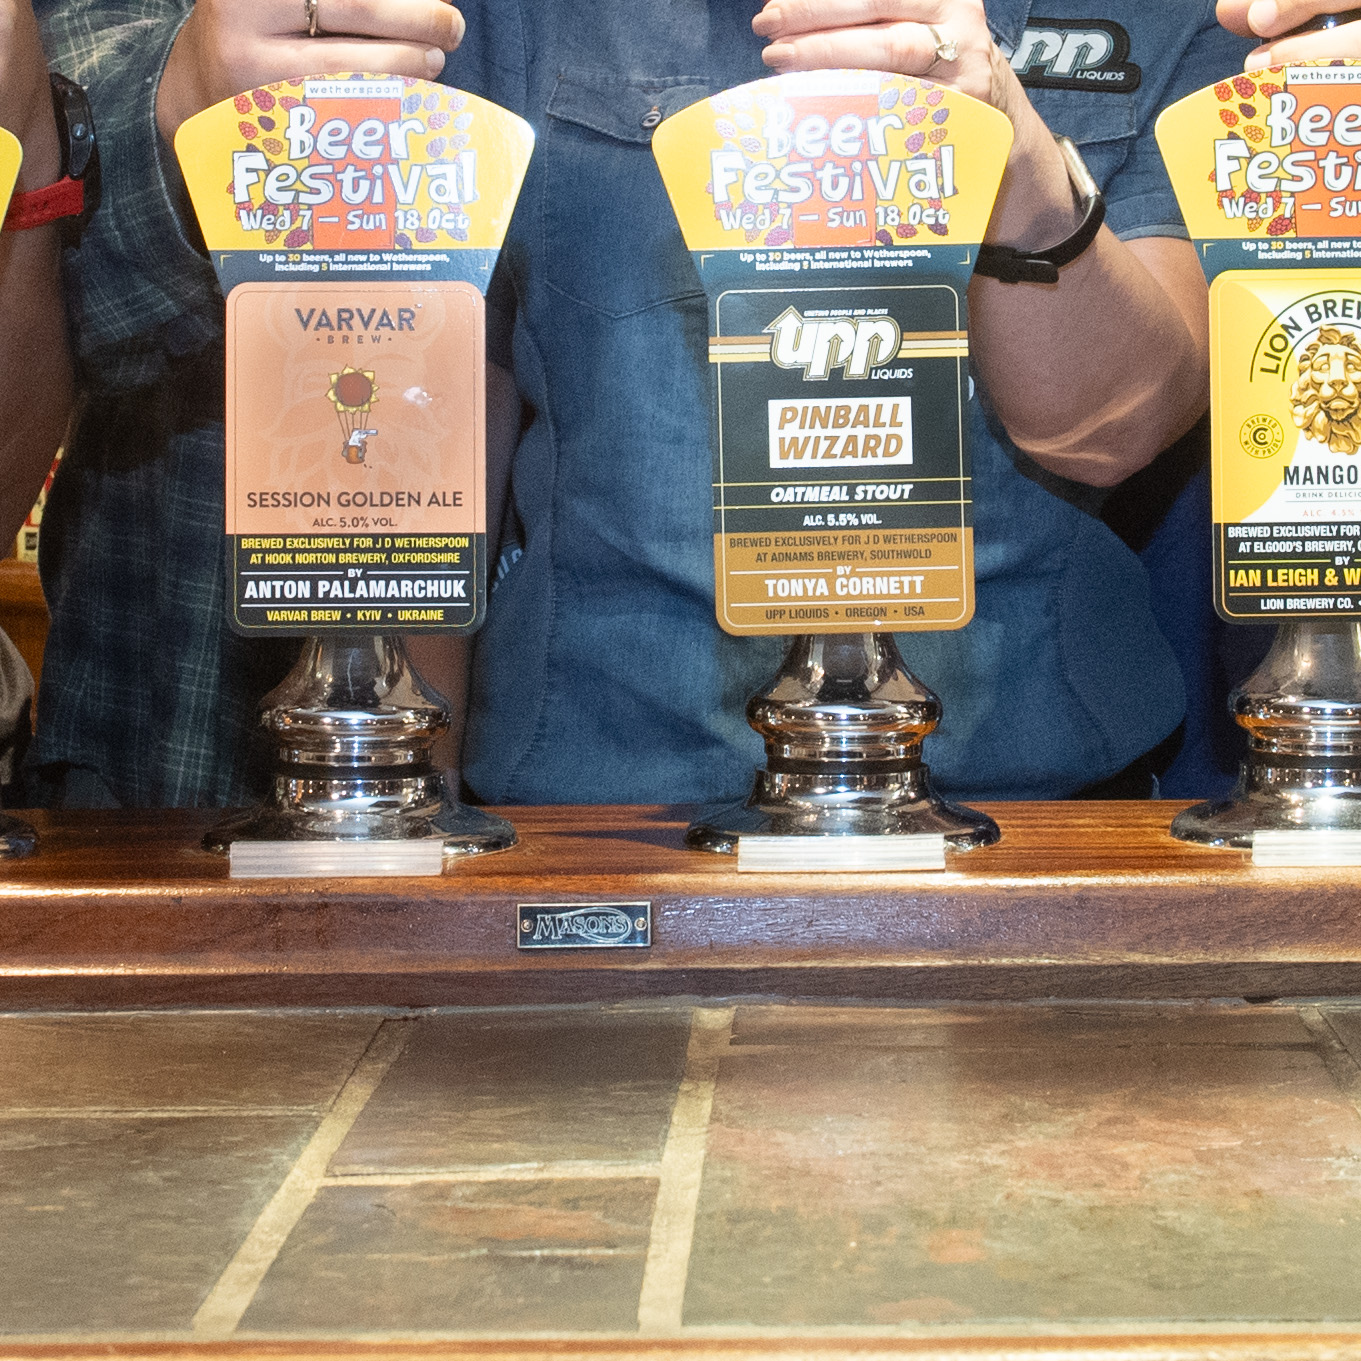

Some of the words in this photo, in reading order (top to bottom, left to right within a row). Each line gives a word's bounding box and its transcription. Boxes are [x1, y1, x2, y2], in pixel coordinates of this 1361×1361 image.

[1076, 71, 1125, 81] LIQUIDS
[309, 85, 400, 96] wetherspoon
[285, 104, 426, 161] Beer
[761, 103, 905, 159] Beer
[231, 150, 480, 205] Festival
[709, 144, 956, 204] Festival
[294, 308, 415, 331] VARVAR
[327, 334, 381, 343] BREW
[1260, 319, 1302, 375] LION
[871, 368, 913, 379] LIQUIDS
[778, 403, 903, 429] PINBALL
[778, 434, 903, 459] WIZARD
[1282, 464, 1358, 485] MANGO
[247, 491, 330, 507] SESSION
[336, 491, 420, 507] GOLDEN
[427, 491, 462, 506] ALE
[770, 485, 849, 502] OATMEAL
[854, 484, 913, 500] STOUT
[249, 553, 263, 563] AT
[265, 553, 293, 563] HOOK
[295, 553, 336, 563] NORTON
[338, 553, 388, 564] BREWERY,
[391, 552, 460, 562] OXFORDSHIRE
[347, 568, 362, 577] BY
[1229, 569, 1261, 586] IAN
[1266, 568, 1318, 586] LEIGH
[1324, 568, 1338, 585] &
[244, 580, 310, 598] ANTON
[317, 579, 466, 598] PALAMARCHUK
[764, 578, 828, 596] TONYA
[835, 575, 924, 595] CORNETT
[1260, 598, 1284, 609] LION
[1286, 598, 1335, 609] BREWERY
[1336, 597, 1354, 608] CO.
[266, 610, 308, 620] VARVAR
[310, 610, 341, 620] BREW
[357, 610, 381, 620] KYIV
[397, 610, 443, 620] UKRAINE
[533, 914, 628, 940] MASONS
